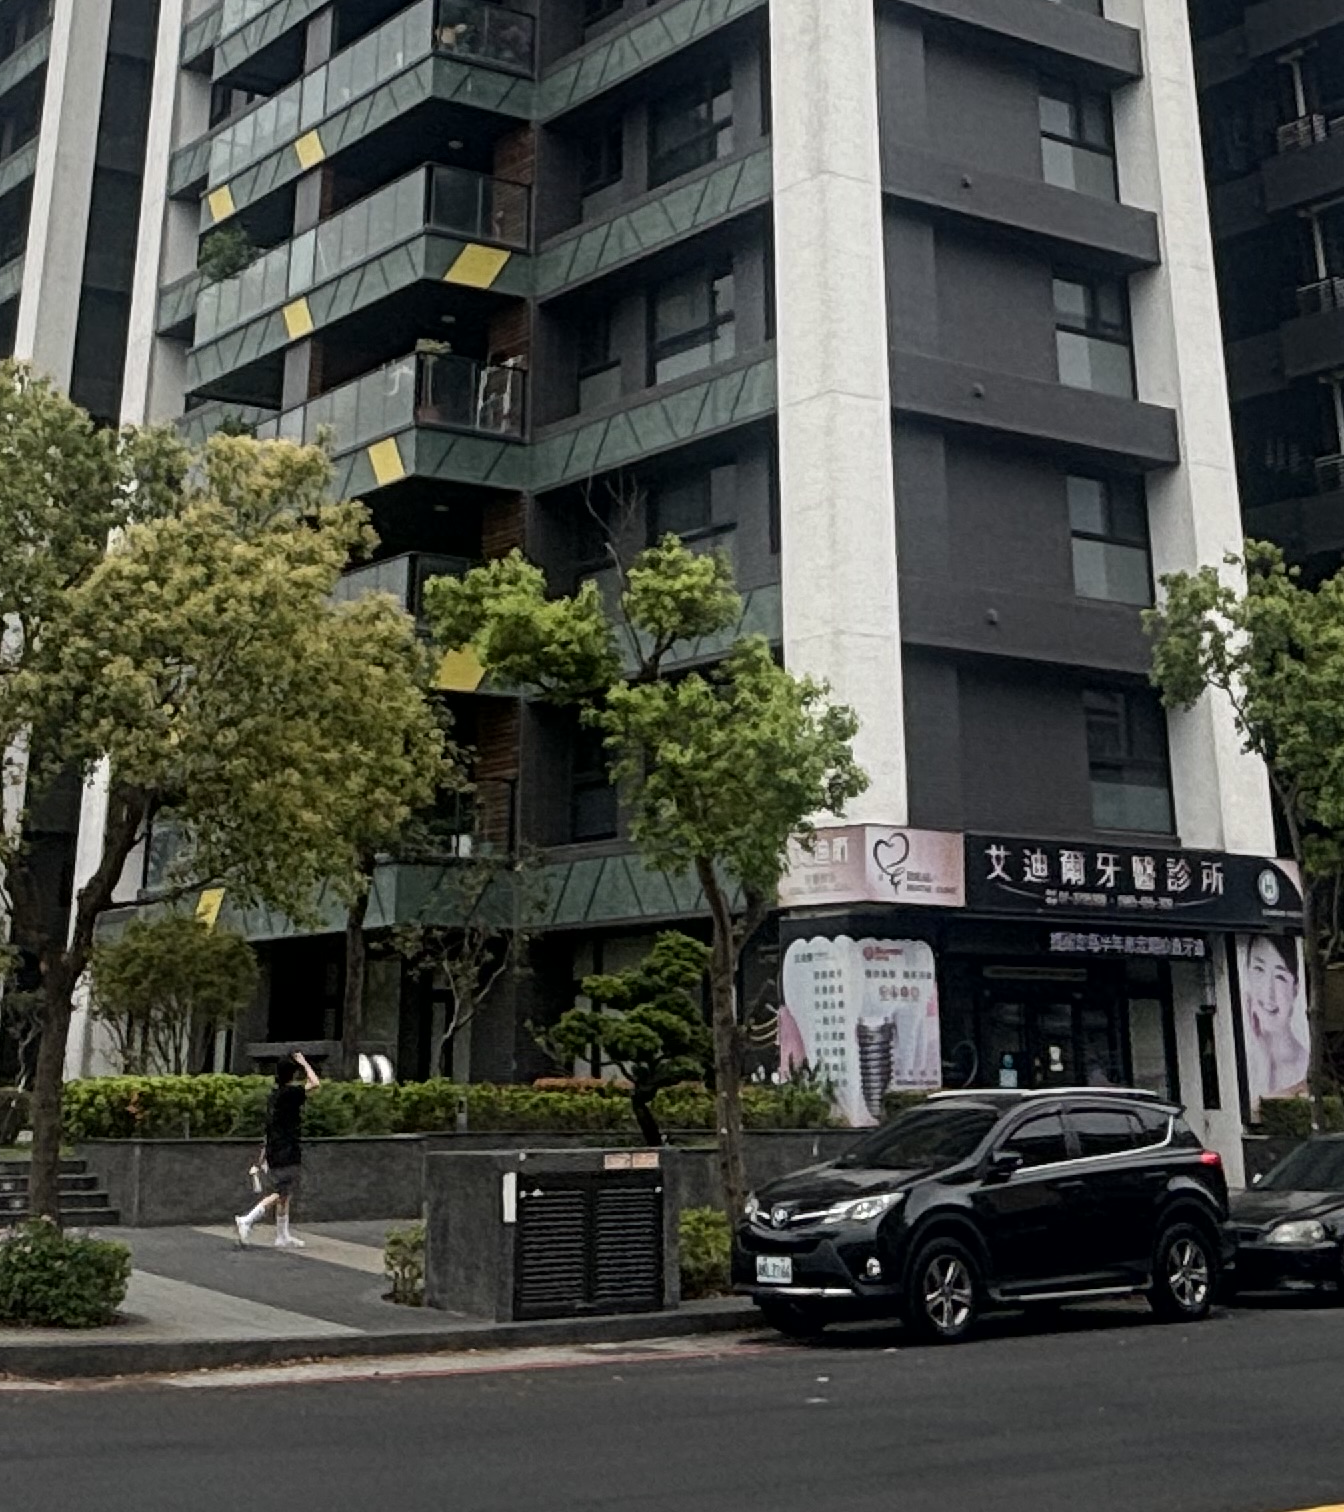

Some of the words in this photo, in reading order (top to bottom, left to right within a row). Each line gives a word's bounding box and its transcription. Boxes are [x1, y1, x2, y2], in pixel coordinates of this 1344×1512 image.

[984, 843, 1224, 895] 艾迪爾牙醫診所
